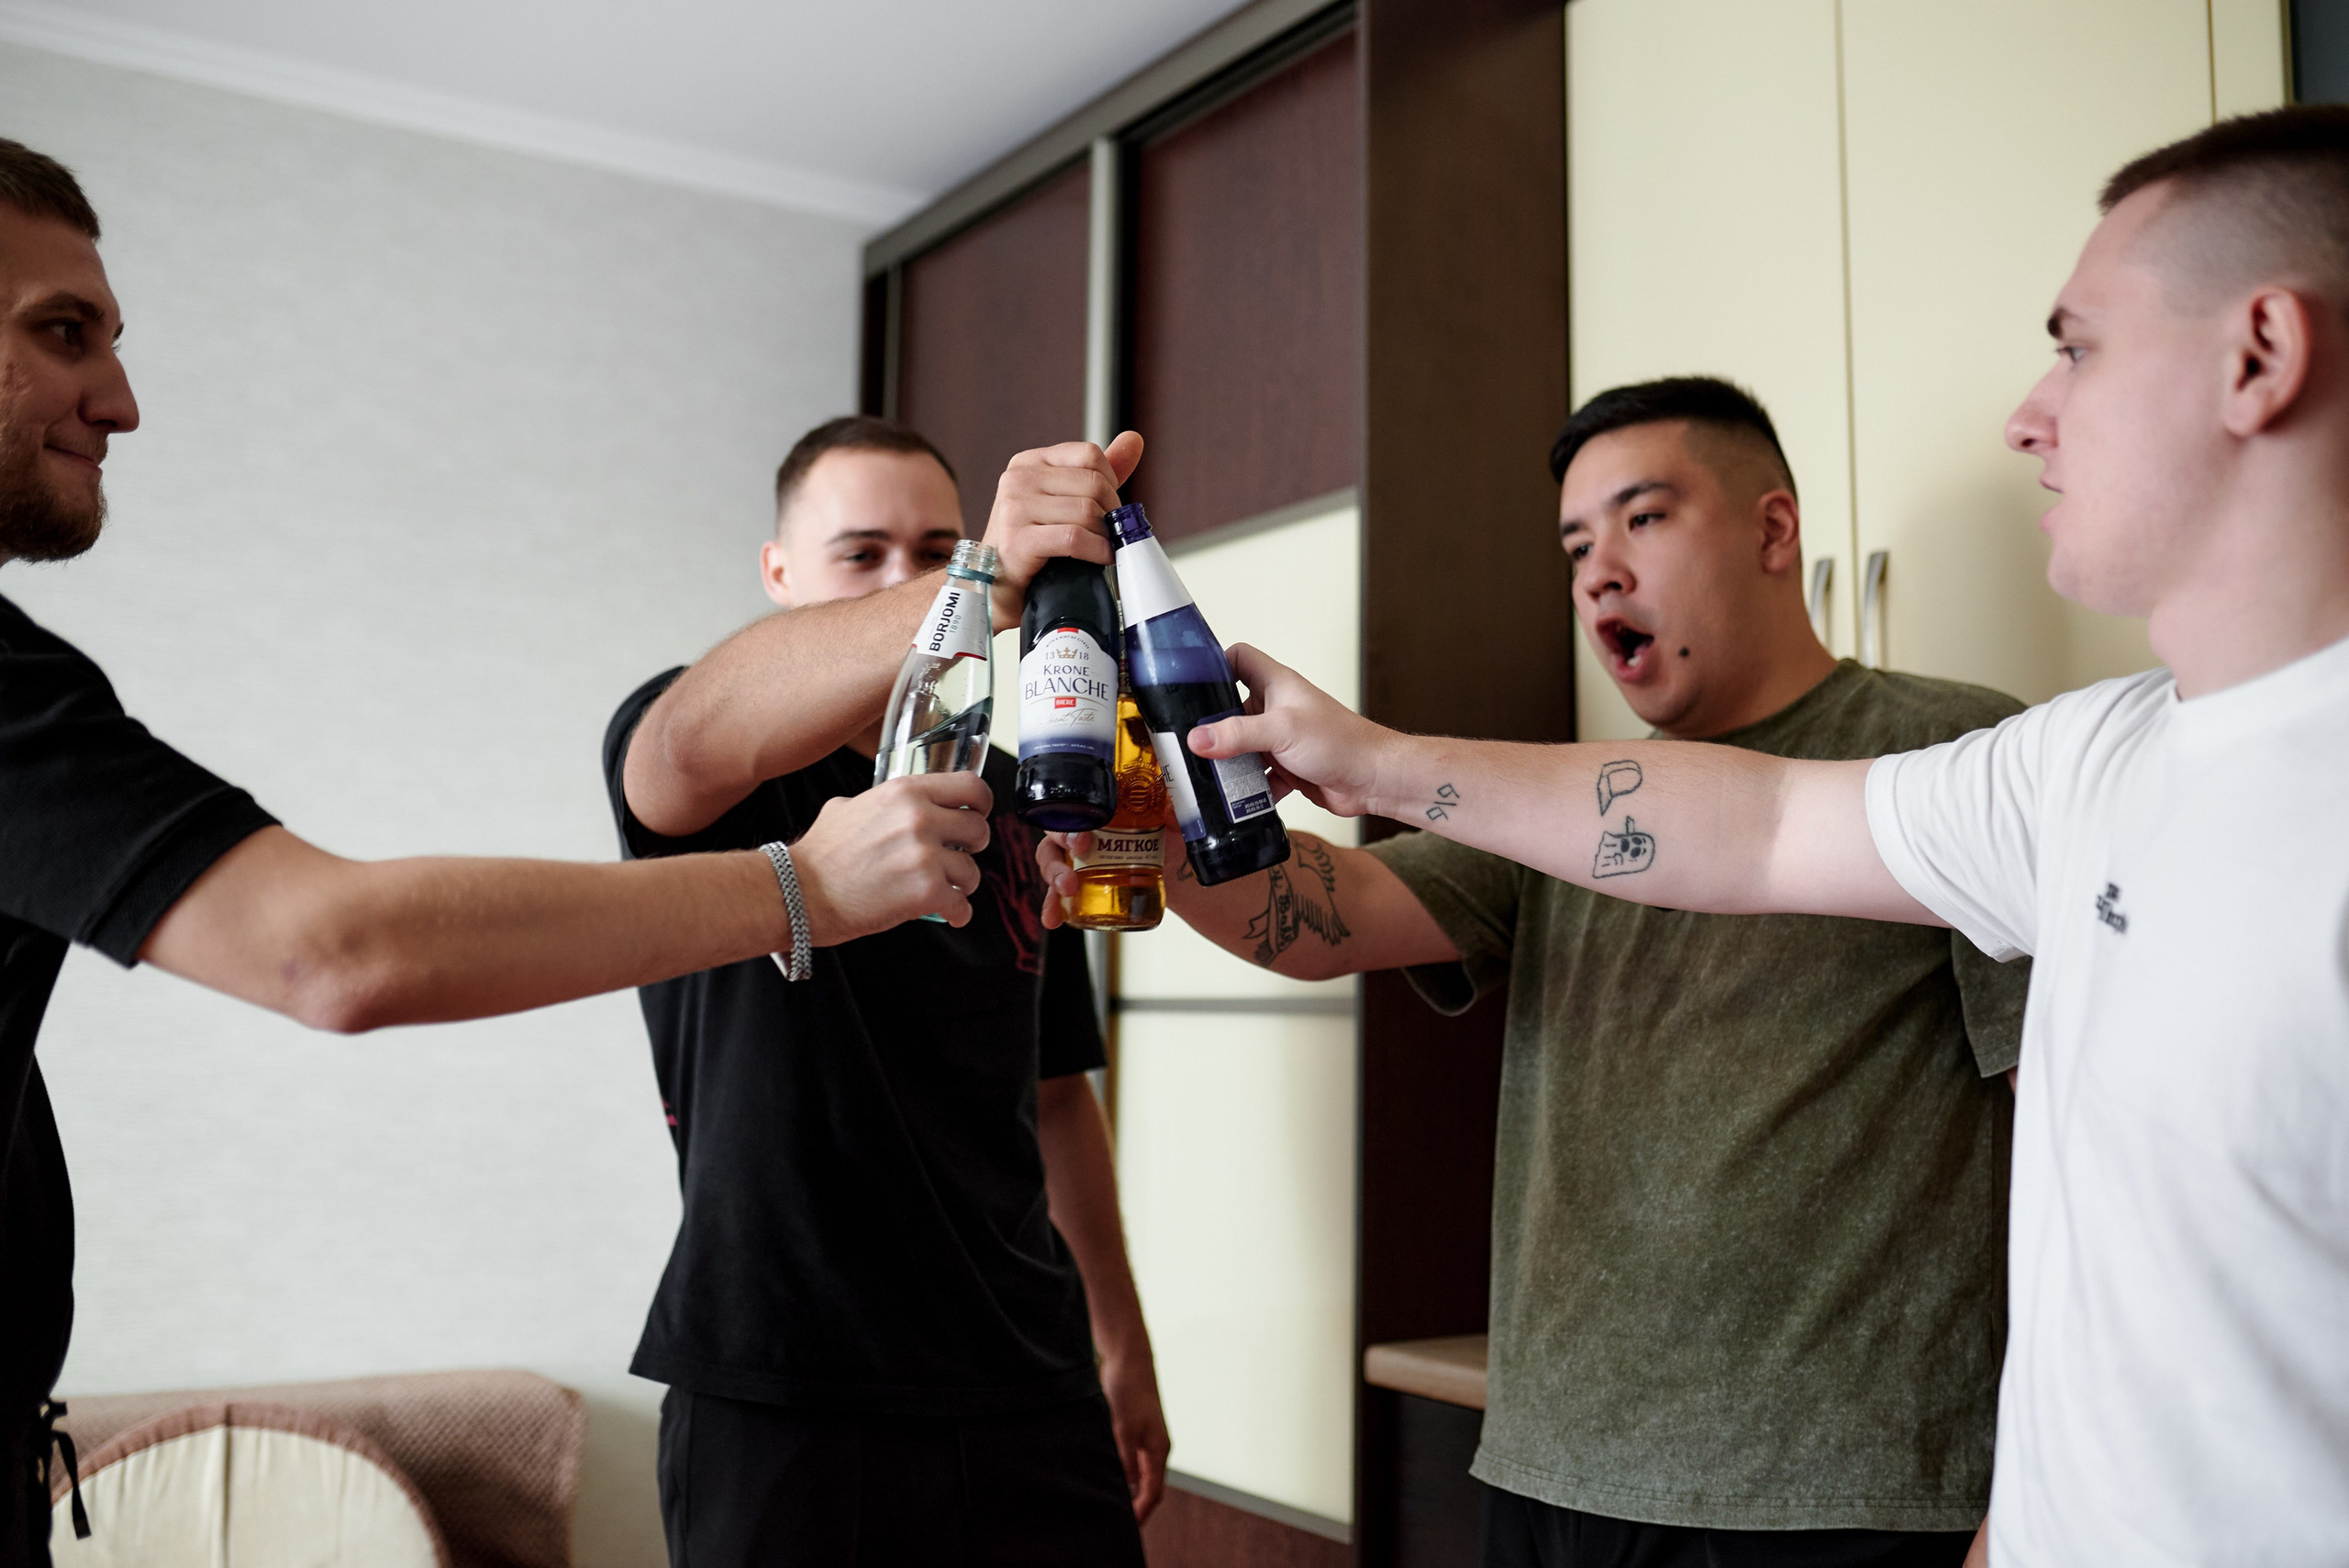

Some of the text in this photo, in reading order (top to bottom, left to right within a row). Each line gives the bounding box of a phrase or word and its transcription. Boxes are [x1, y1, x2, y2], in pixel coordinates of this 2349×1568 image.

[929, 592, 961, 651] BORJOMI
[949, 614, 962, 633] 1890
[1045, 651, 1090, 661] 13 18
[1043, 663, 1090, 677] KRONE
[1025, 677, 1108, 701] BLANCHE
[1097, 838, 1160, 852] МЯГКОЕ
